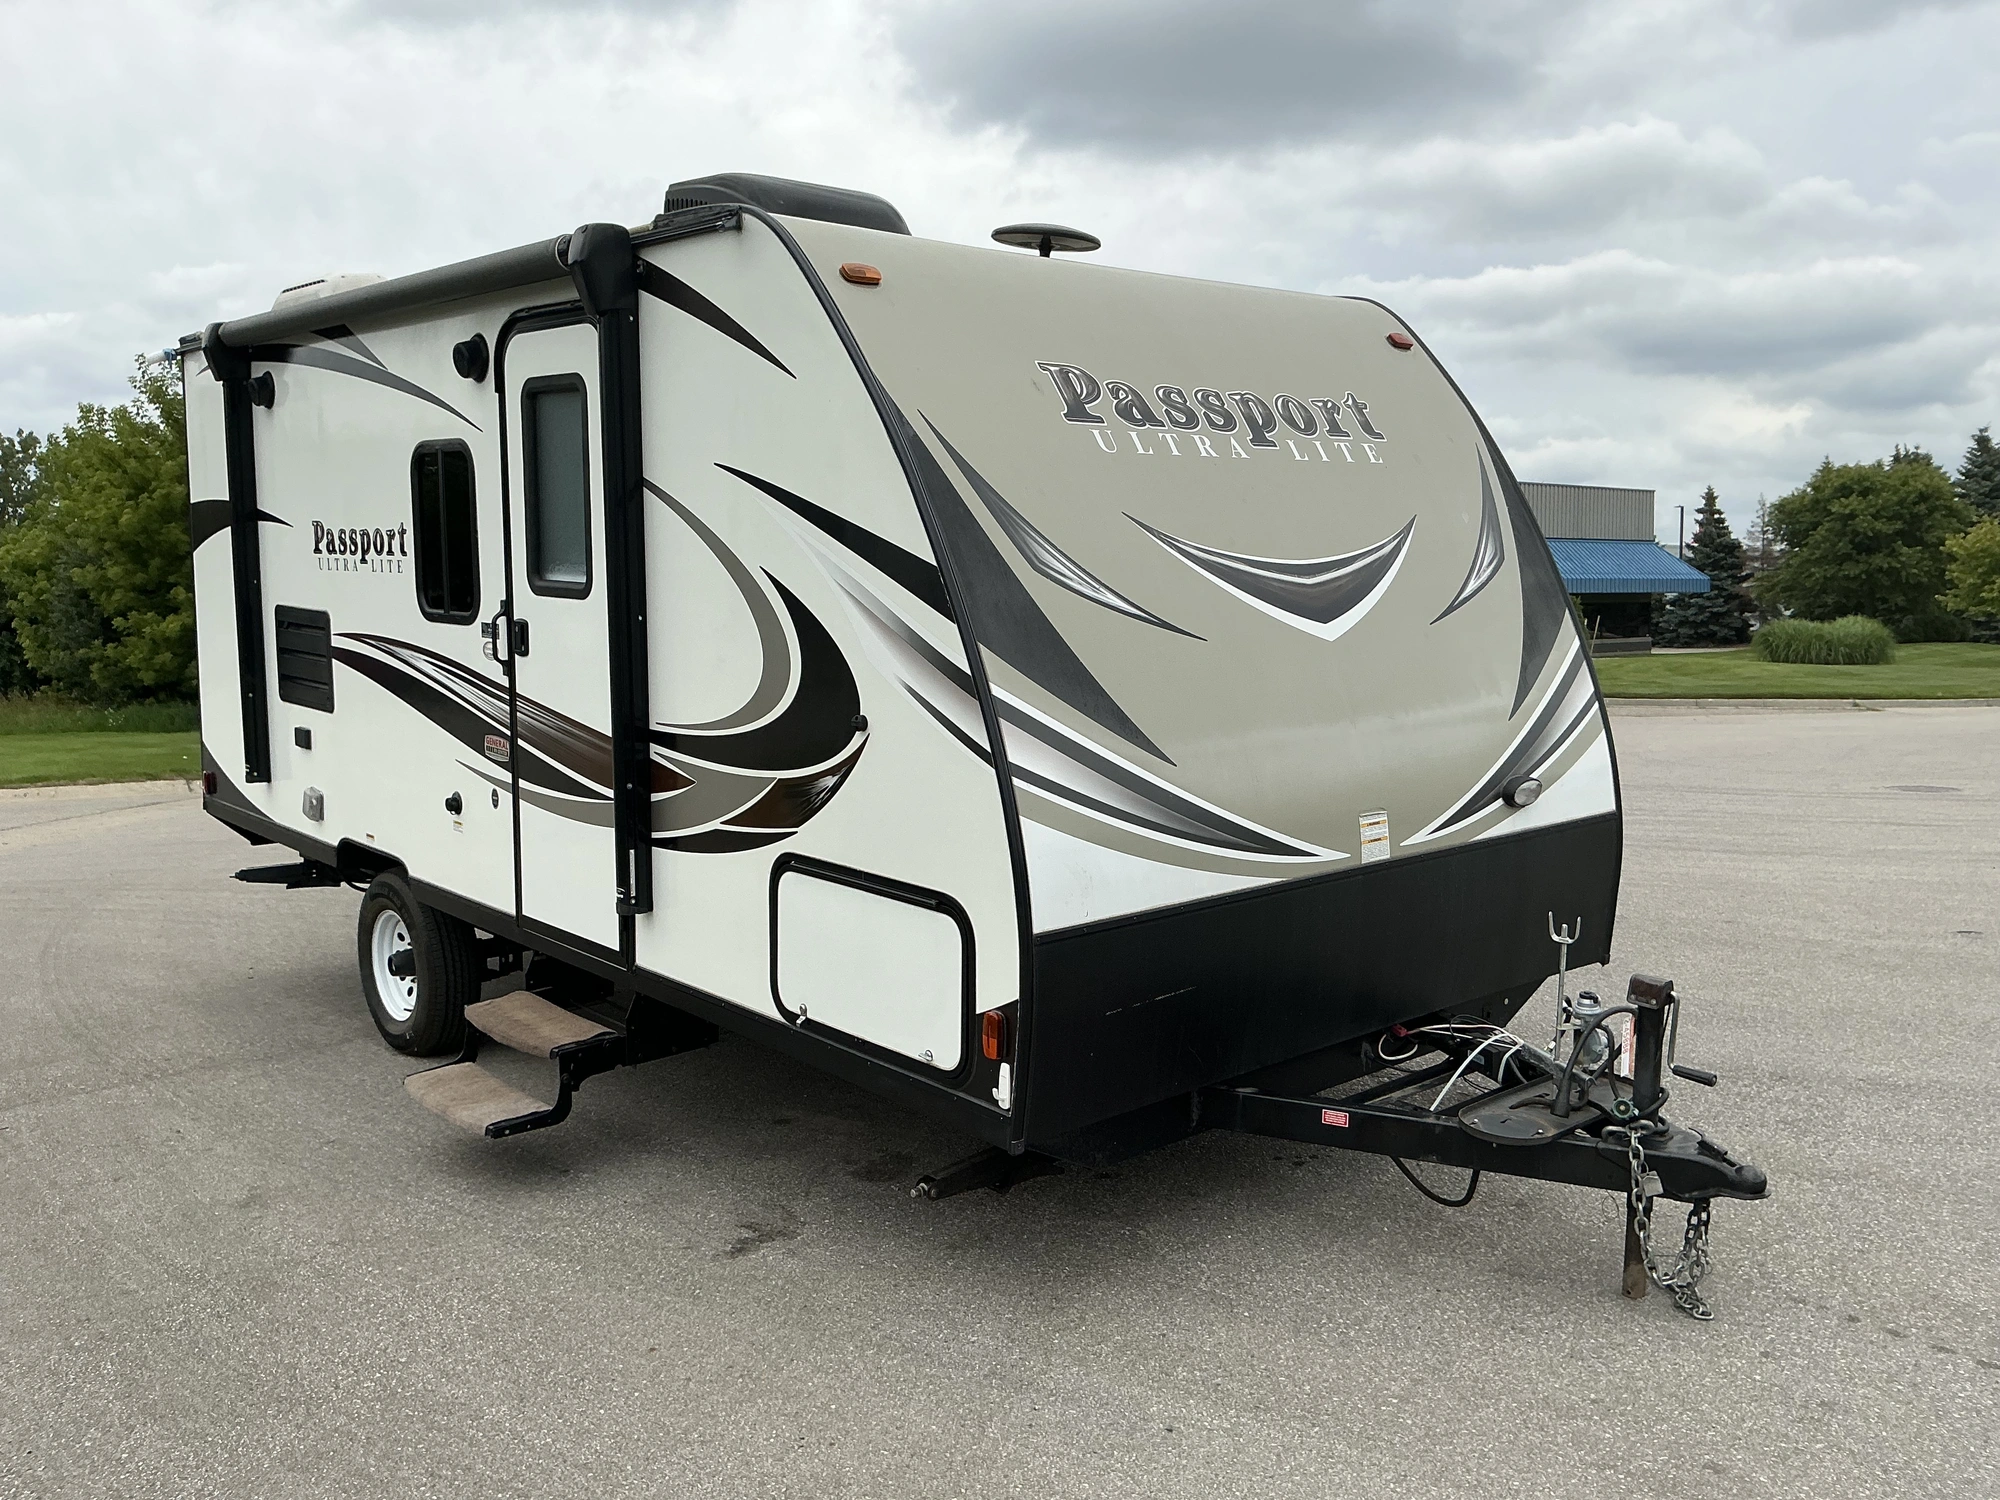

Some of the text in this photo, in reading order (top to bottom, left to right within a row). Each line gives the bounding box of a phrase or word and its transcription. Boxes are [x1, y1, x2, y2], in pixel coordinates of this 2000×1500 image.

[1034, 361, 1386, 449] Passport
[1089, 429, 1384, 464] ULTRA LITE
[312, 520, 407, 564] Passport
[318, 557, 403, 573] ULTRA LITE
[486, 736, 508, 750] GENERAL
